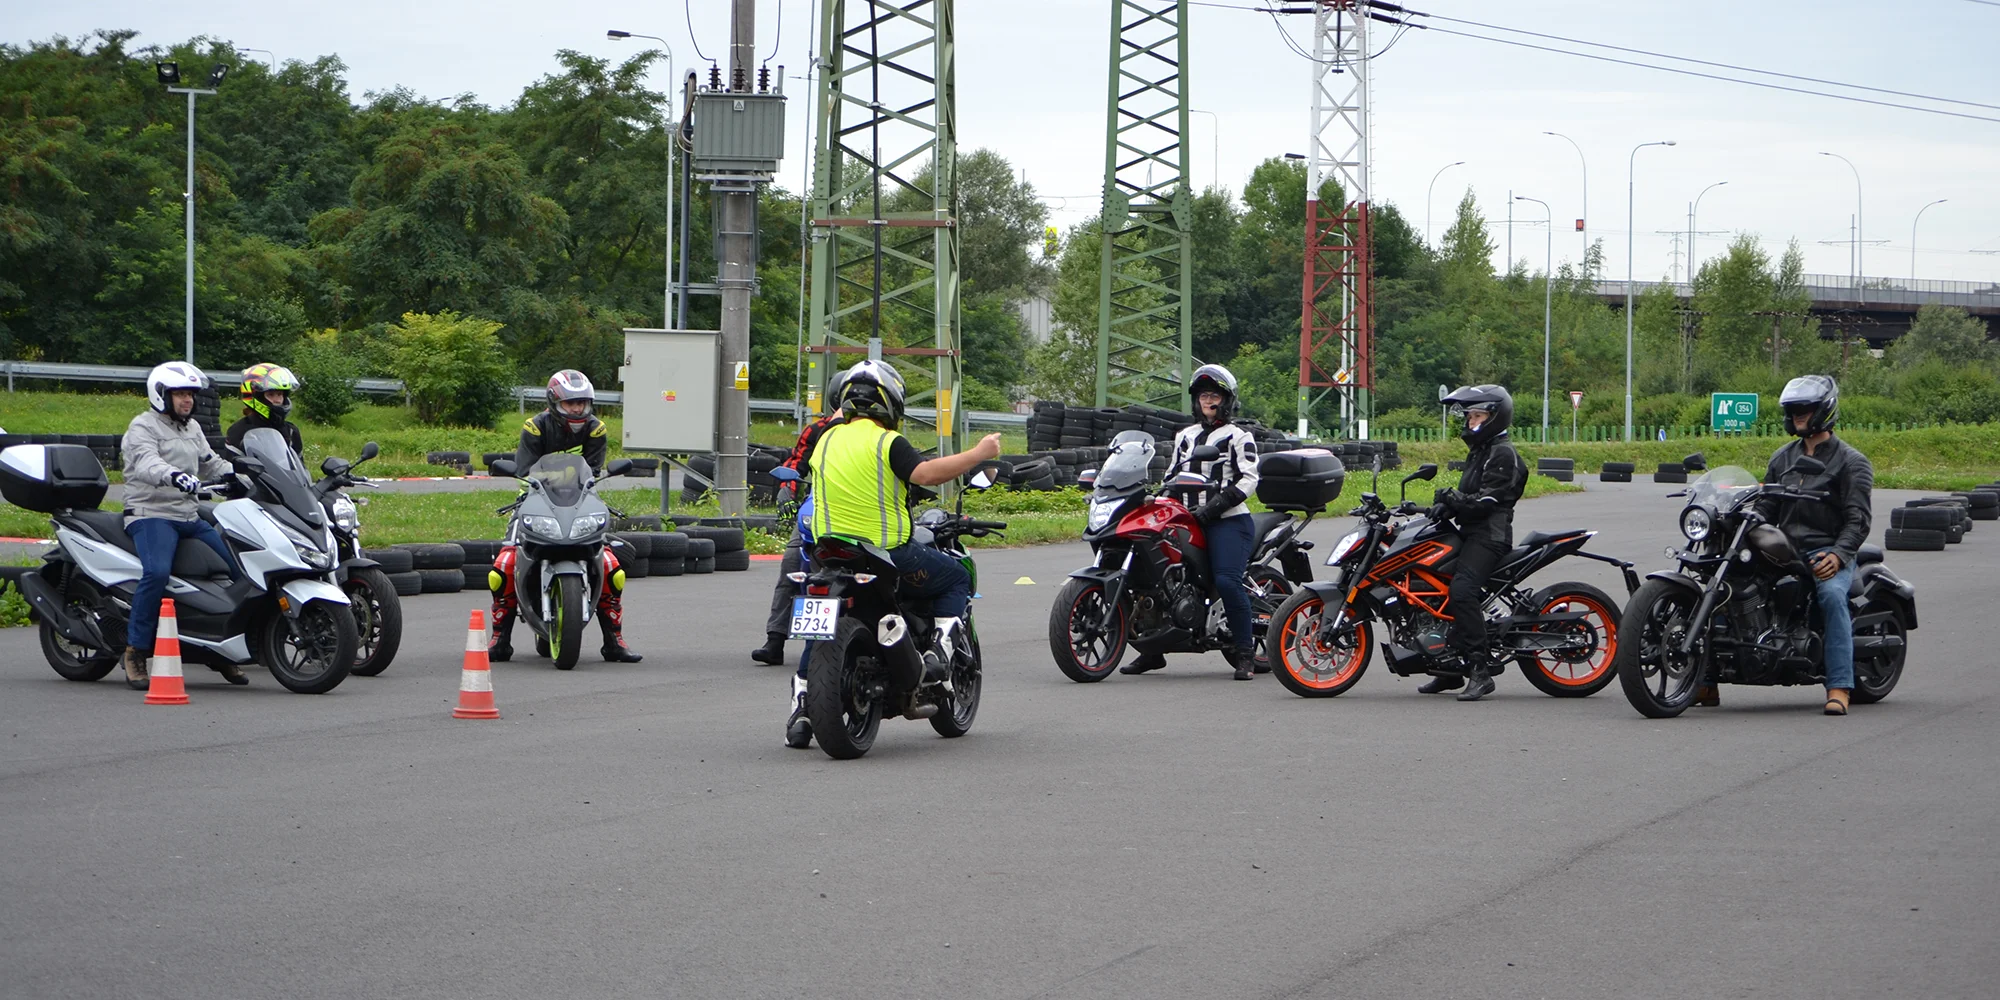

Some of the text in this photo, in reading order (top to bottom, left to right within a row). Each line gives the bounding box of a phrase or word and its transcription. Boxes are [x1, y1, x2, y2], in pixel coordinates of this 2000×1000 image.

[1724, 419, 1737, 427] 1000
[805, 601, 822, 614] 9T
[794, 618, 828, 631] 5734
